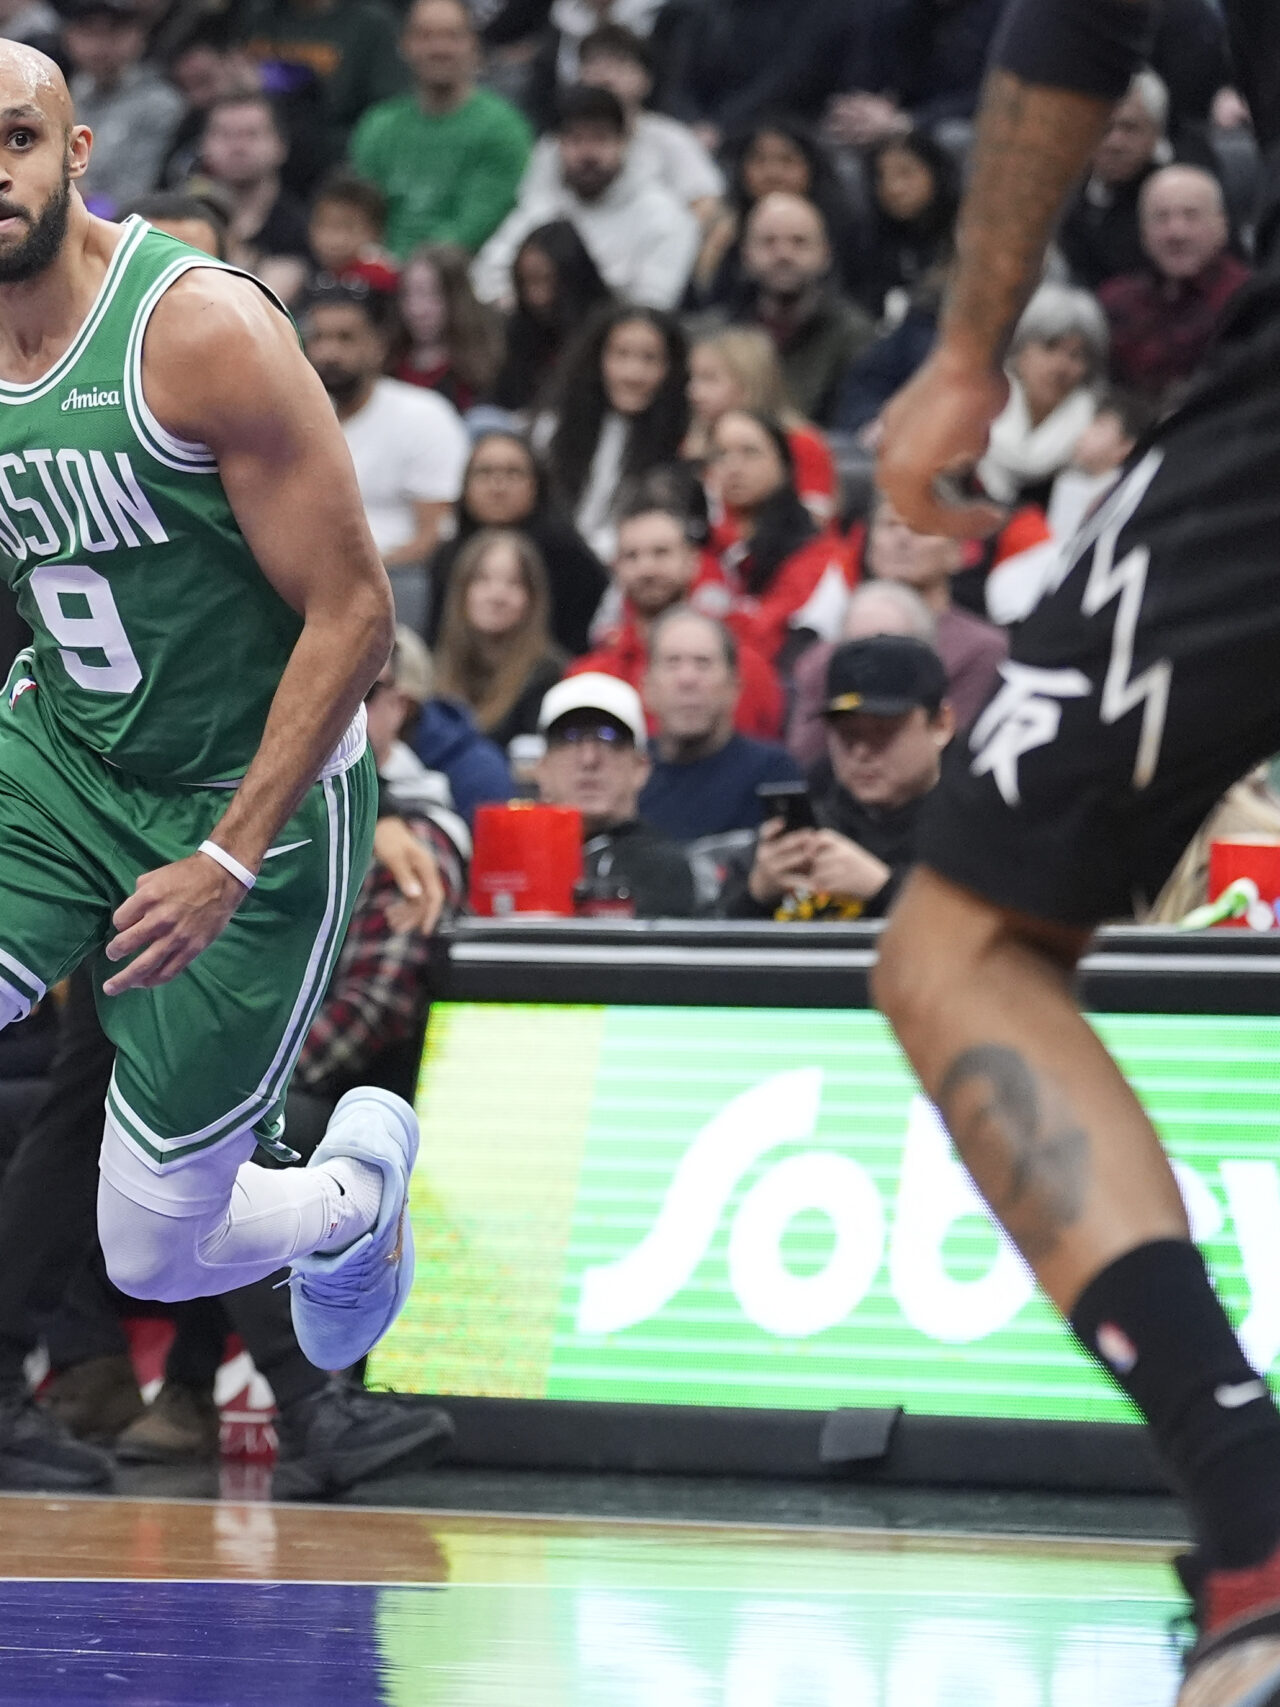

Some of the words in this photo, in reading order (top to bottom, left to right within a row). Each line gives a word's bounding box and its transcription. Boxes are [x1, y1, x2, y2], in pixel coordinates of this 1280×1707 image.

[61, 386, 120, 411] Amica
[29, 565, 142, 693] 9
[576, 1066, 1280, 1378] Soby
